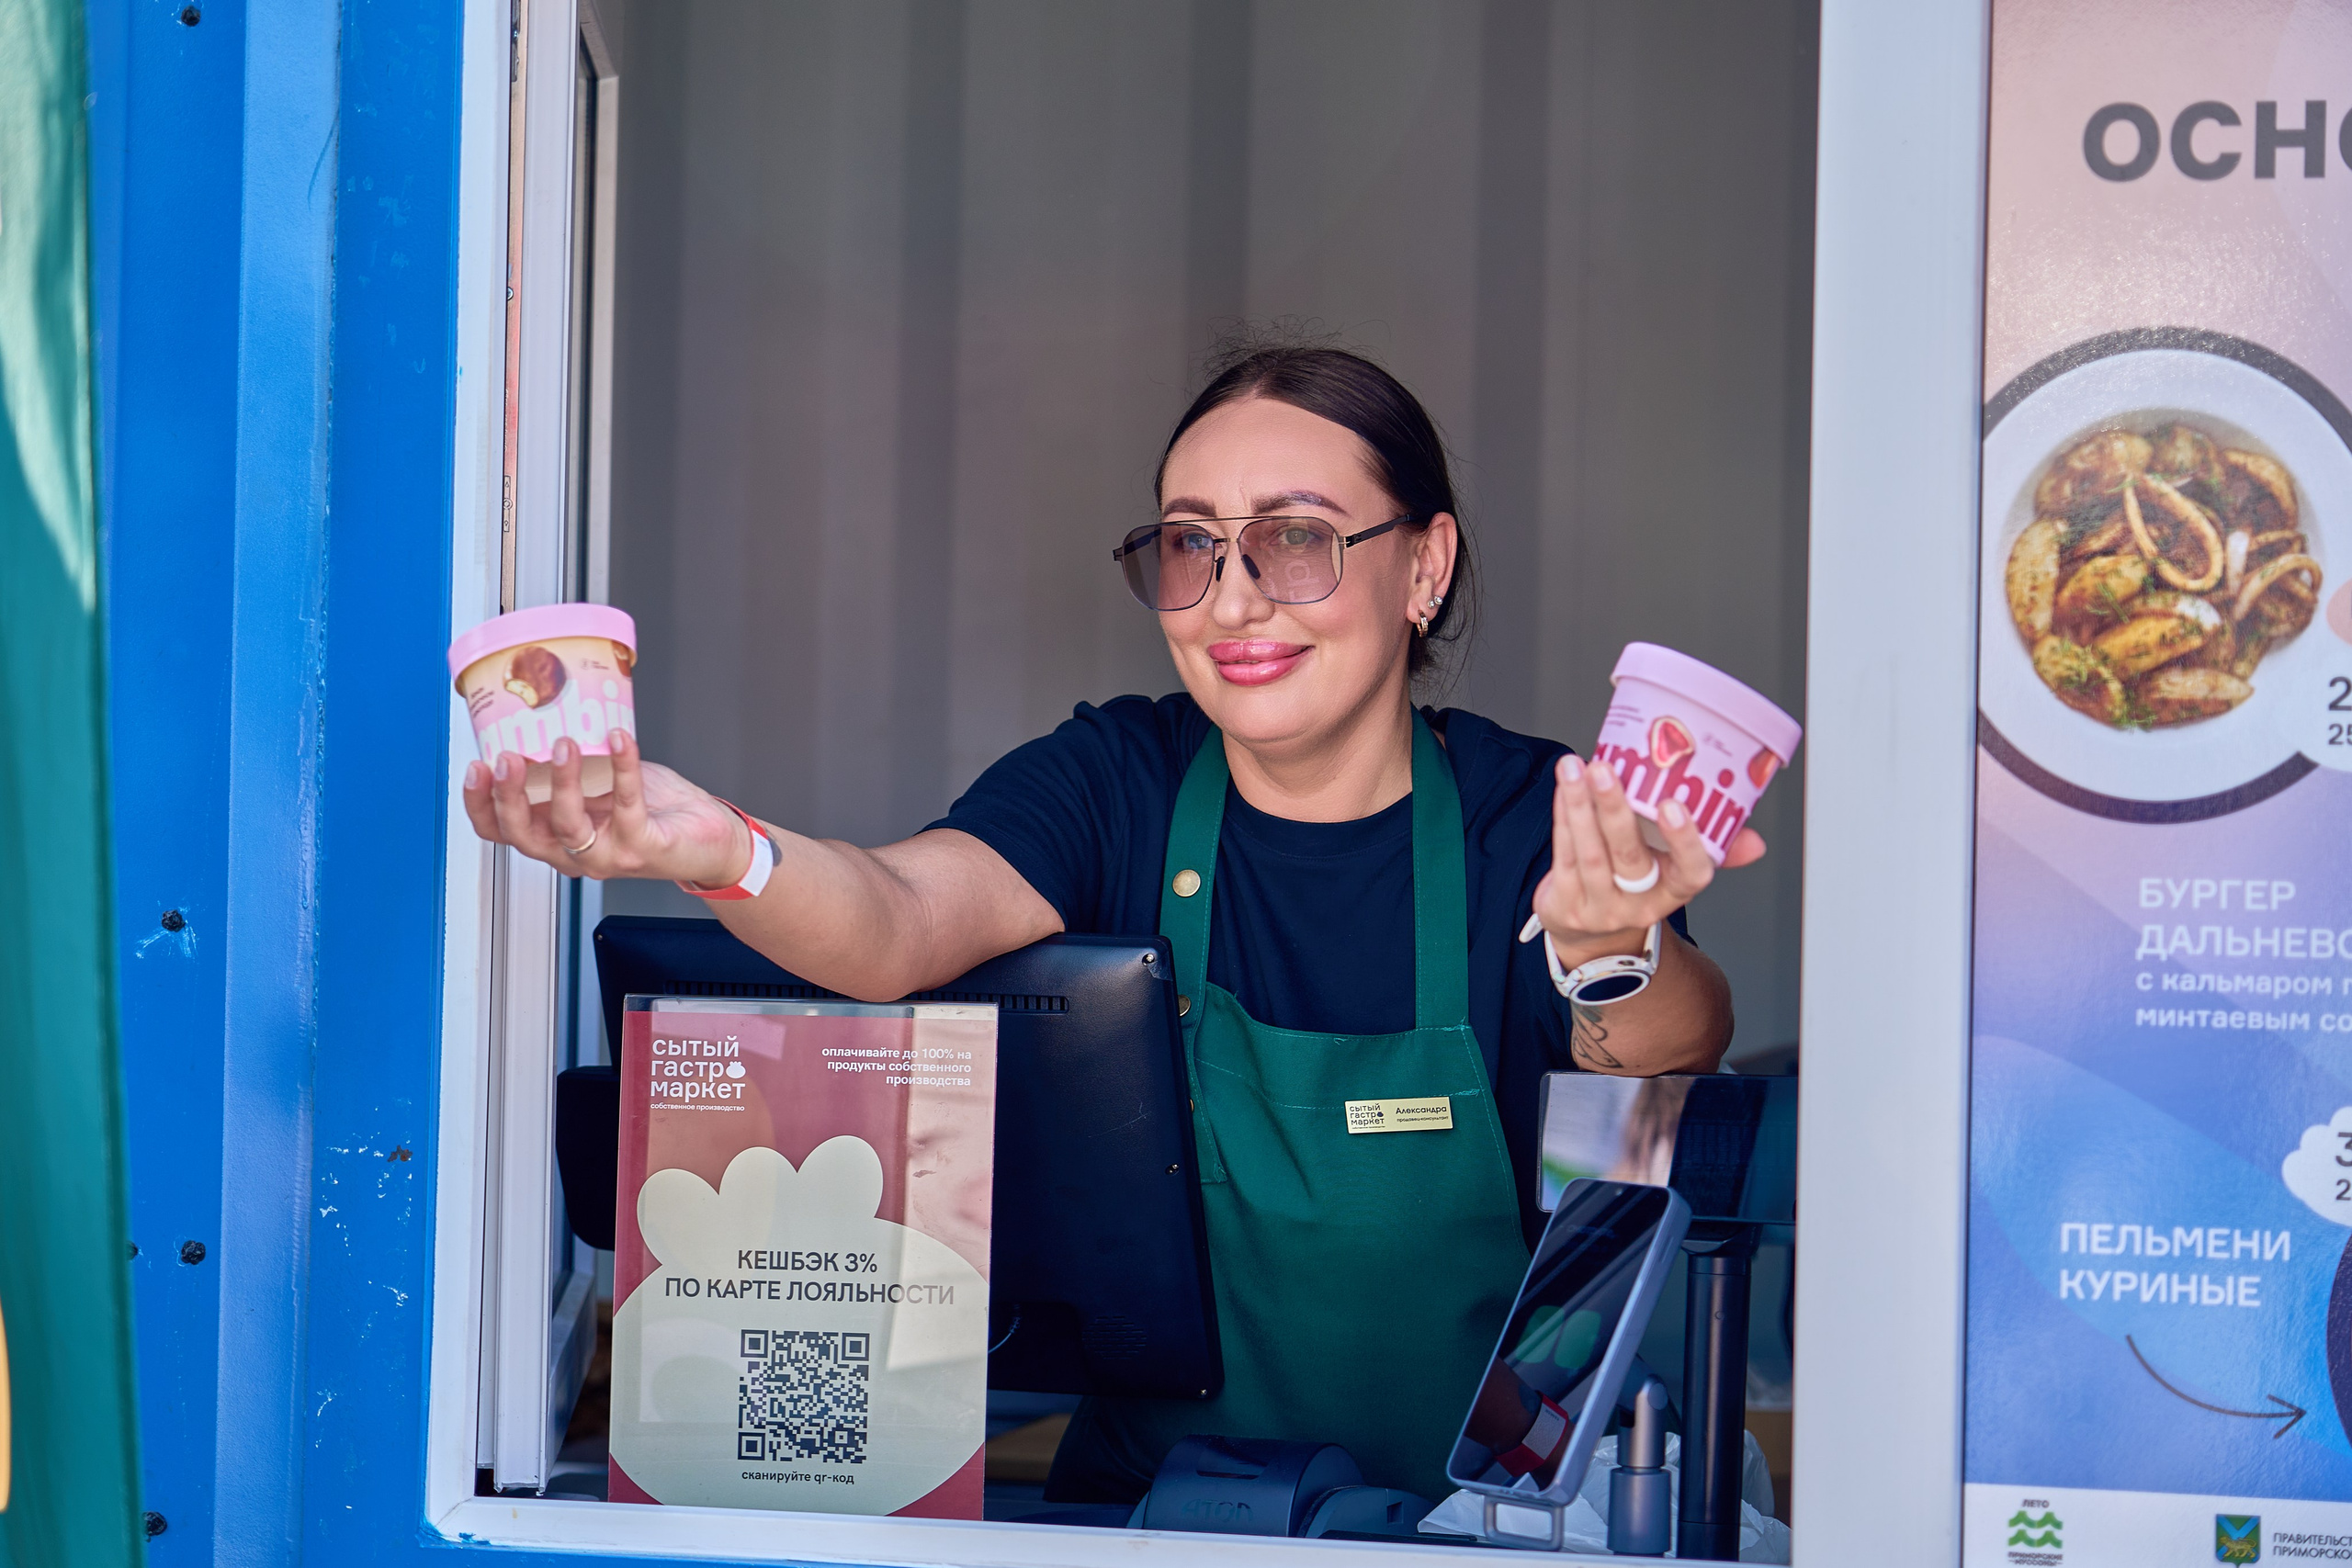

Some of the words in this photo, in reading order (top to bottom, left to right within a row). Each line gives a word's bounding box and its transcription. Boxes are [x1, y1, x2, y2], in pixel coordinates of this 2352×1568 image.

[2083, 100, 2352, 183] ОСН
[2139, 877, 2296, 910] БУРГЕР
[2135, 972, 2154, 991] с
[2161, 973, 2333, 999] кальмаром
[2135, 1008, 2311, 1031] минтаевым
[652, 1035, 739, 1057] сытый
[821, 1047, 899, 1057] оплачивайте
[902, 1049, 918, 1059] до
[922, 1048, 954, 1059] 100%
[957, 1051, 971, 1059] на
[827, 1061, 886, 1072] продукты
[888, 1061, 971, 1073] собственного
[650, 1081, 745, 1102] маркет
[886, 1075, 971, 1087] производства
[1349, 1103, 1380, 1112] сытый
[1396, 1106, 1447, 1114] Александра
[1351, 1118, 1385, 1127] маркет
[2060, 1223, 2291, 1262] ПЕЛЬМЕНИ
[738, 1249, 838, 1272] КЕШБЭК
[844, 1252, 877, 1273] 3%
[665, 1278, 700, 1297] ПО
[707, 1279, 780, 1300] КАРТЕ
[786, 1280, 954, 1305] ЛОЯЛЬНОСТИ
[2060, 1269, 2261, 1307] КУРИНЫЕ
[741, 1471, 811, 1483] сканируйте
[814, 1473, 854, 1484] qr-код
[2022, 1499, 2050, 1508] ЛЕТО
[2273, 1545, 2352, 1560] ПРИМОРСКО
